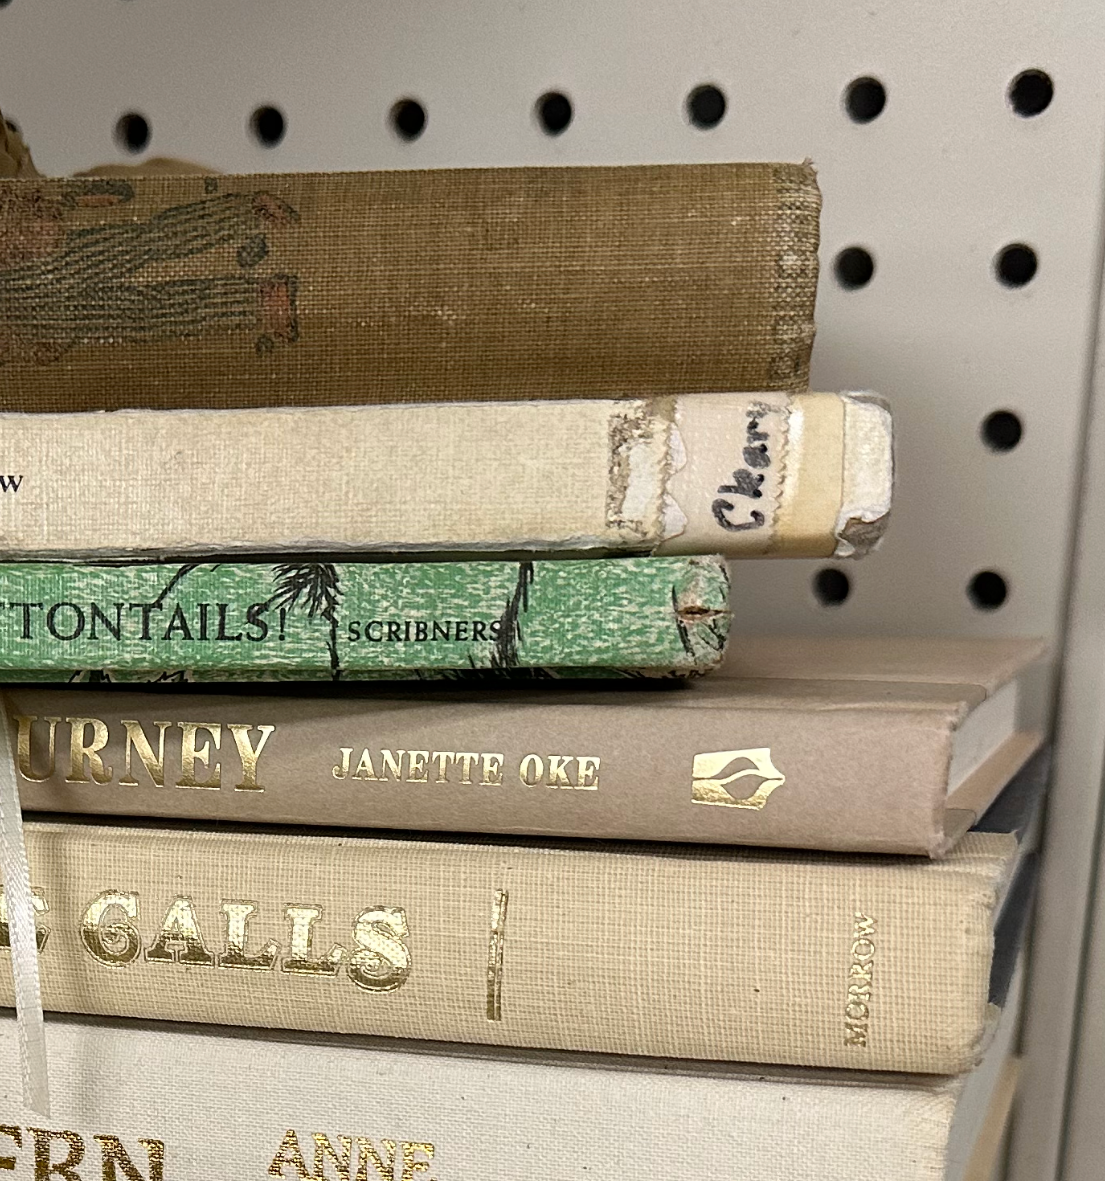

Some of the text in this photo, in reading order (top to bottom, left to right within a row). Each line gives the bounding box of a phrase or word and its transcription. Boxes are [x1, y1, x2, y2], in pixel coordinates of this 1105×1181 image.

[347, 618, 504, 644] SCRIBNERS
[331, 745, 503, 788] JANETTE
[520, 753, 601, 792] OKE
[79, 888, 414, 994] CALLS
[843, 910, 878, 1049] MORROW
